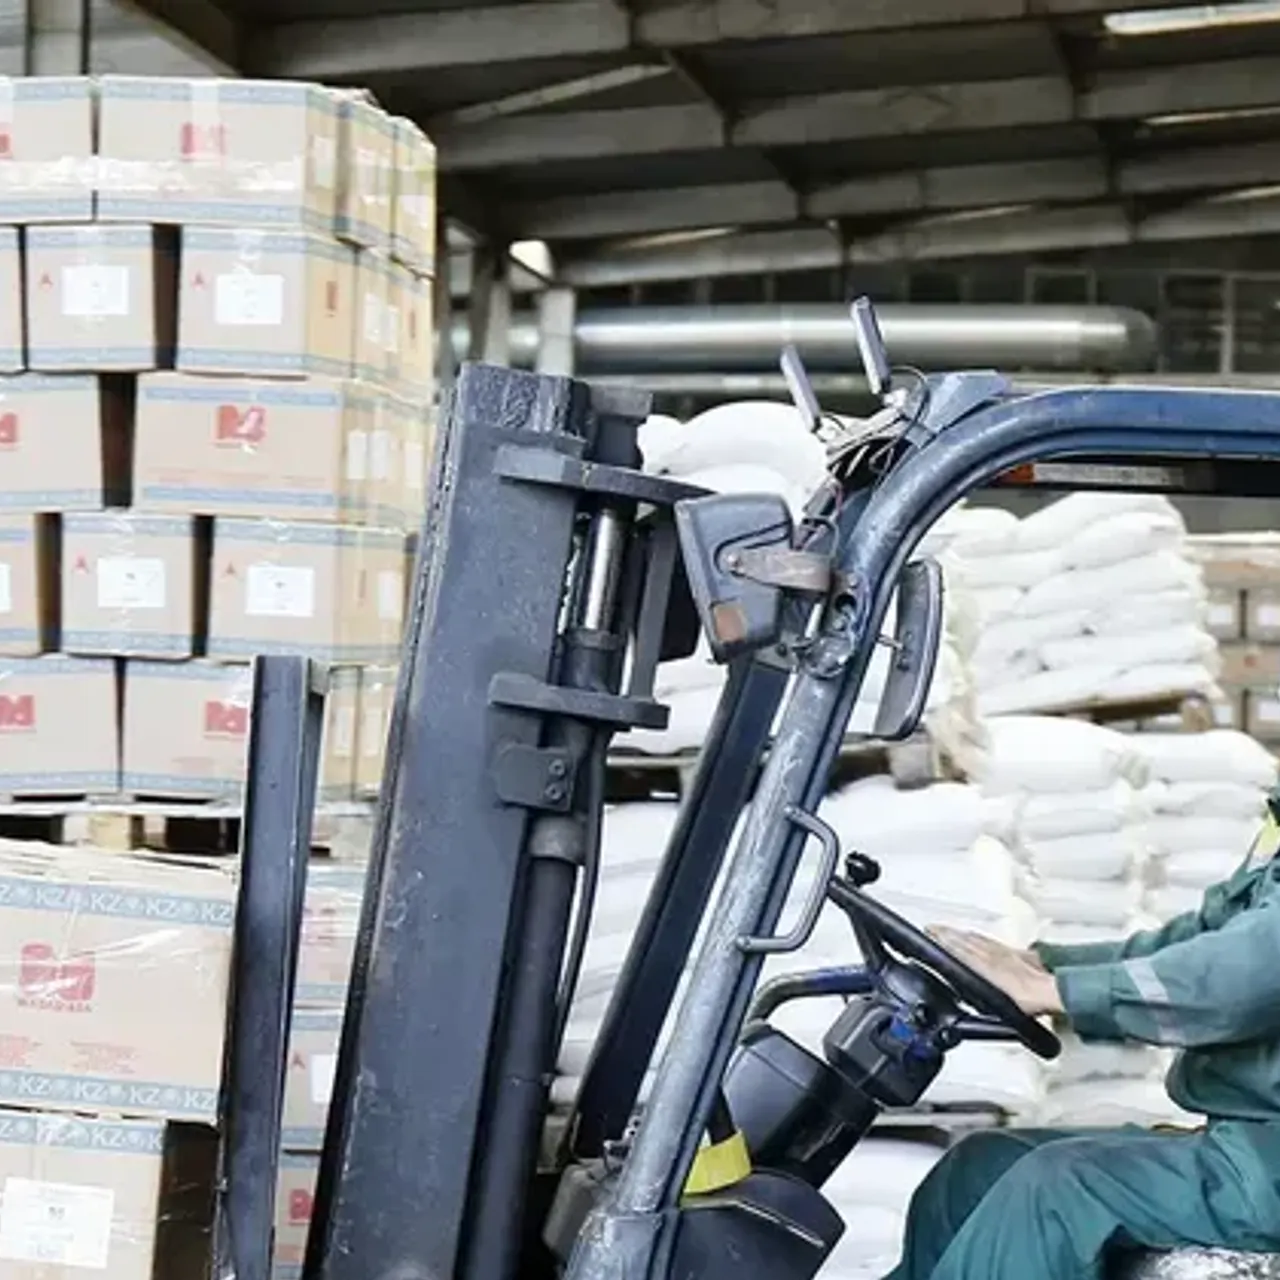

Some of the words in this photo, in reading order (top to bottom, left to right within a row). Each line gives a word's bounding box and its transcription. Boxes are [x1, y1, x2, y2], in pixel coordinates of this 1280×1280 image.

[35, 887, 66, 906] KZ
[90, 892, 122, 911] KZ
[146, 898, 177, 917] KZ
[201, 902, 232, 921] KZ
[18, 1076, 50, 1095] KZ
[73, 1081, 105, 1100] KZ
[129, 1086, 161, 1105] KZ
[183, 1091, 215, 1110] KZ
[91, 1127, 123, 1146] KZ
